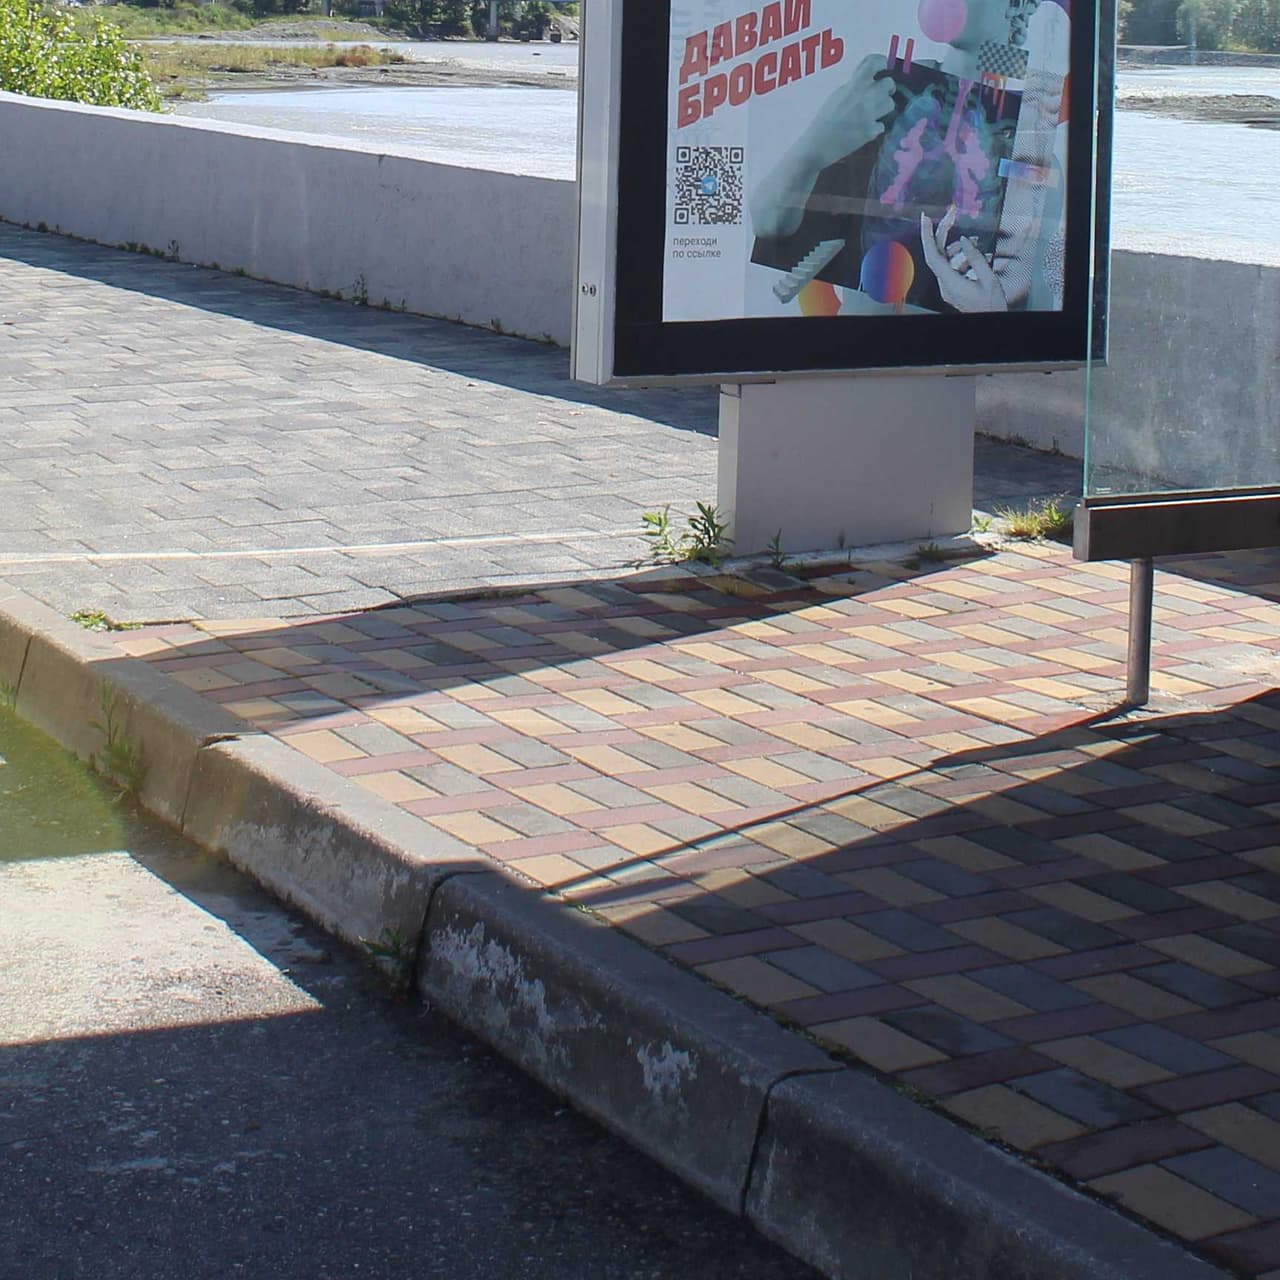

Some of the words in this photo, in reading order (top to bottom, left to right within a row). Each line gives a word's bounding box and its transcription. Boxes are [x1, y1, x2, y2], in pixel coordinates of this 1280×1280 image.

[677, 28, 844, 129] БРОСАТЬ
[673, 237, 718, 248] переходи
[672, 250, 685, 259] по
[687, 250, 721, 258] ссылке
